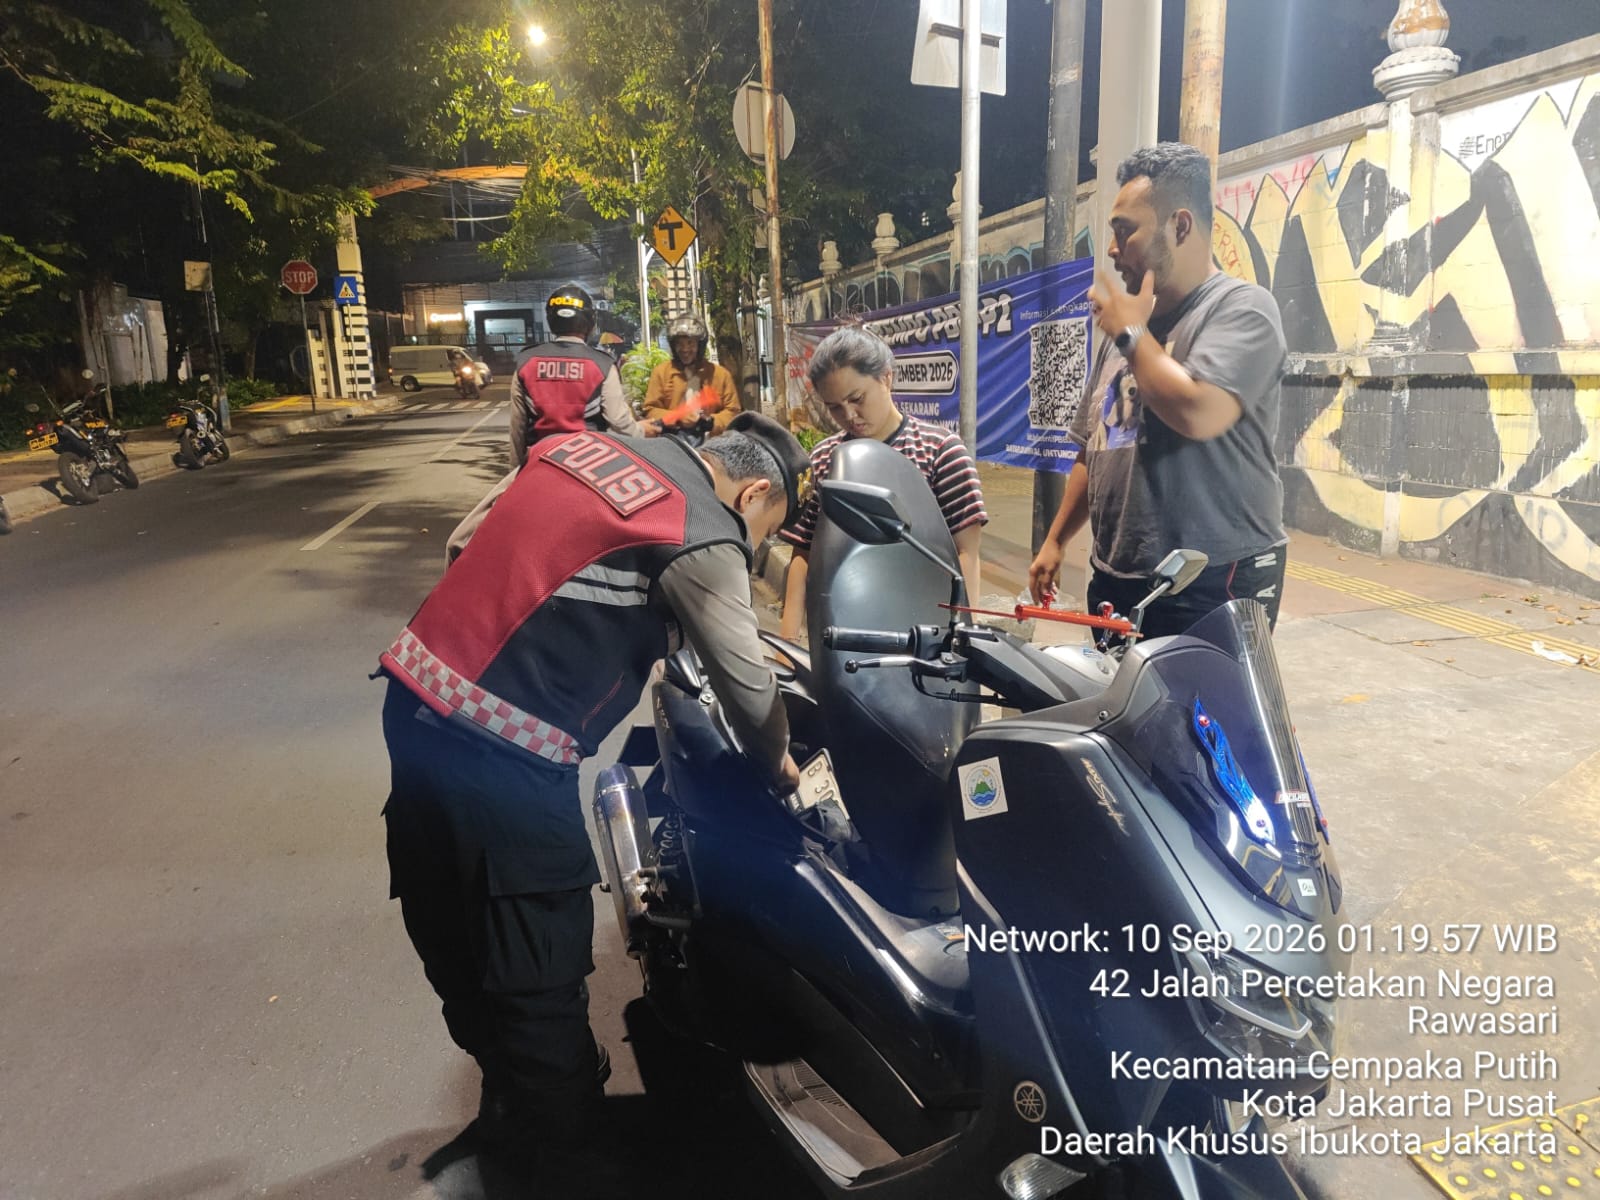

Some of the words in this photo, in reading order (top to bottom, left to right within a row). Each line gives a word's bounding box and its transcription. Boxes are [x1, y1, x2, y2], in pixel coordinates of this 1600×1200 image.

[285, 271, 314, 283] STOP
[537, 361, 585, 379] POLISI
[897, 363, 928, 382] EMBER
[929, 361, 953, 381] 2026
[900, 401, 940, 417] SEKARANG
[545, 431, 669, 512] POLISI
[807, 760, 823, 778] B
